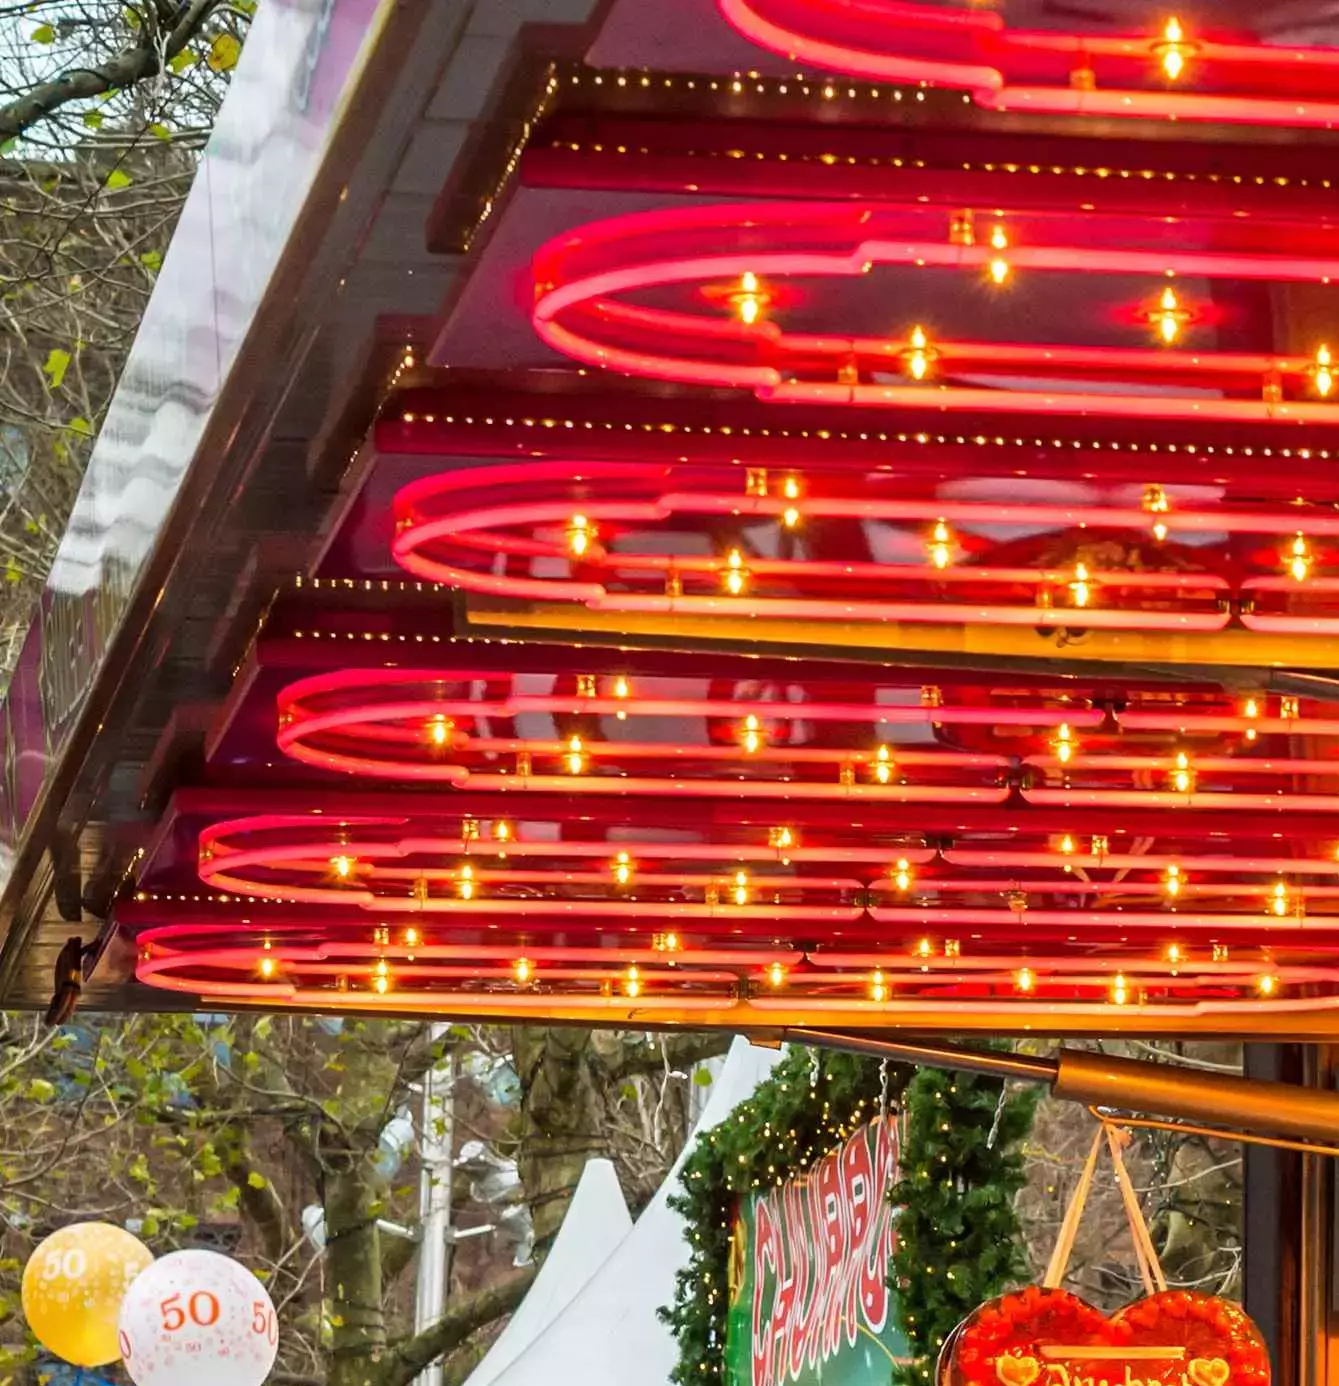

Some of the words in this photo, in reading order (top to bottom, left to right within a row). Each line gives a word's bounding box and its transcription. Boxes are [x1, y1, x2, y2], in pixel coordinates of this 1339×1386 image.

[43, 1249, 87, 1281] 50
[123, 1260, 141, 1286] 5
[160, 1290, 221, 1332] 50
